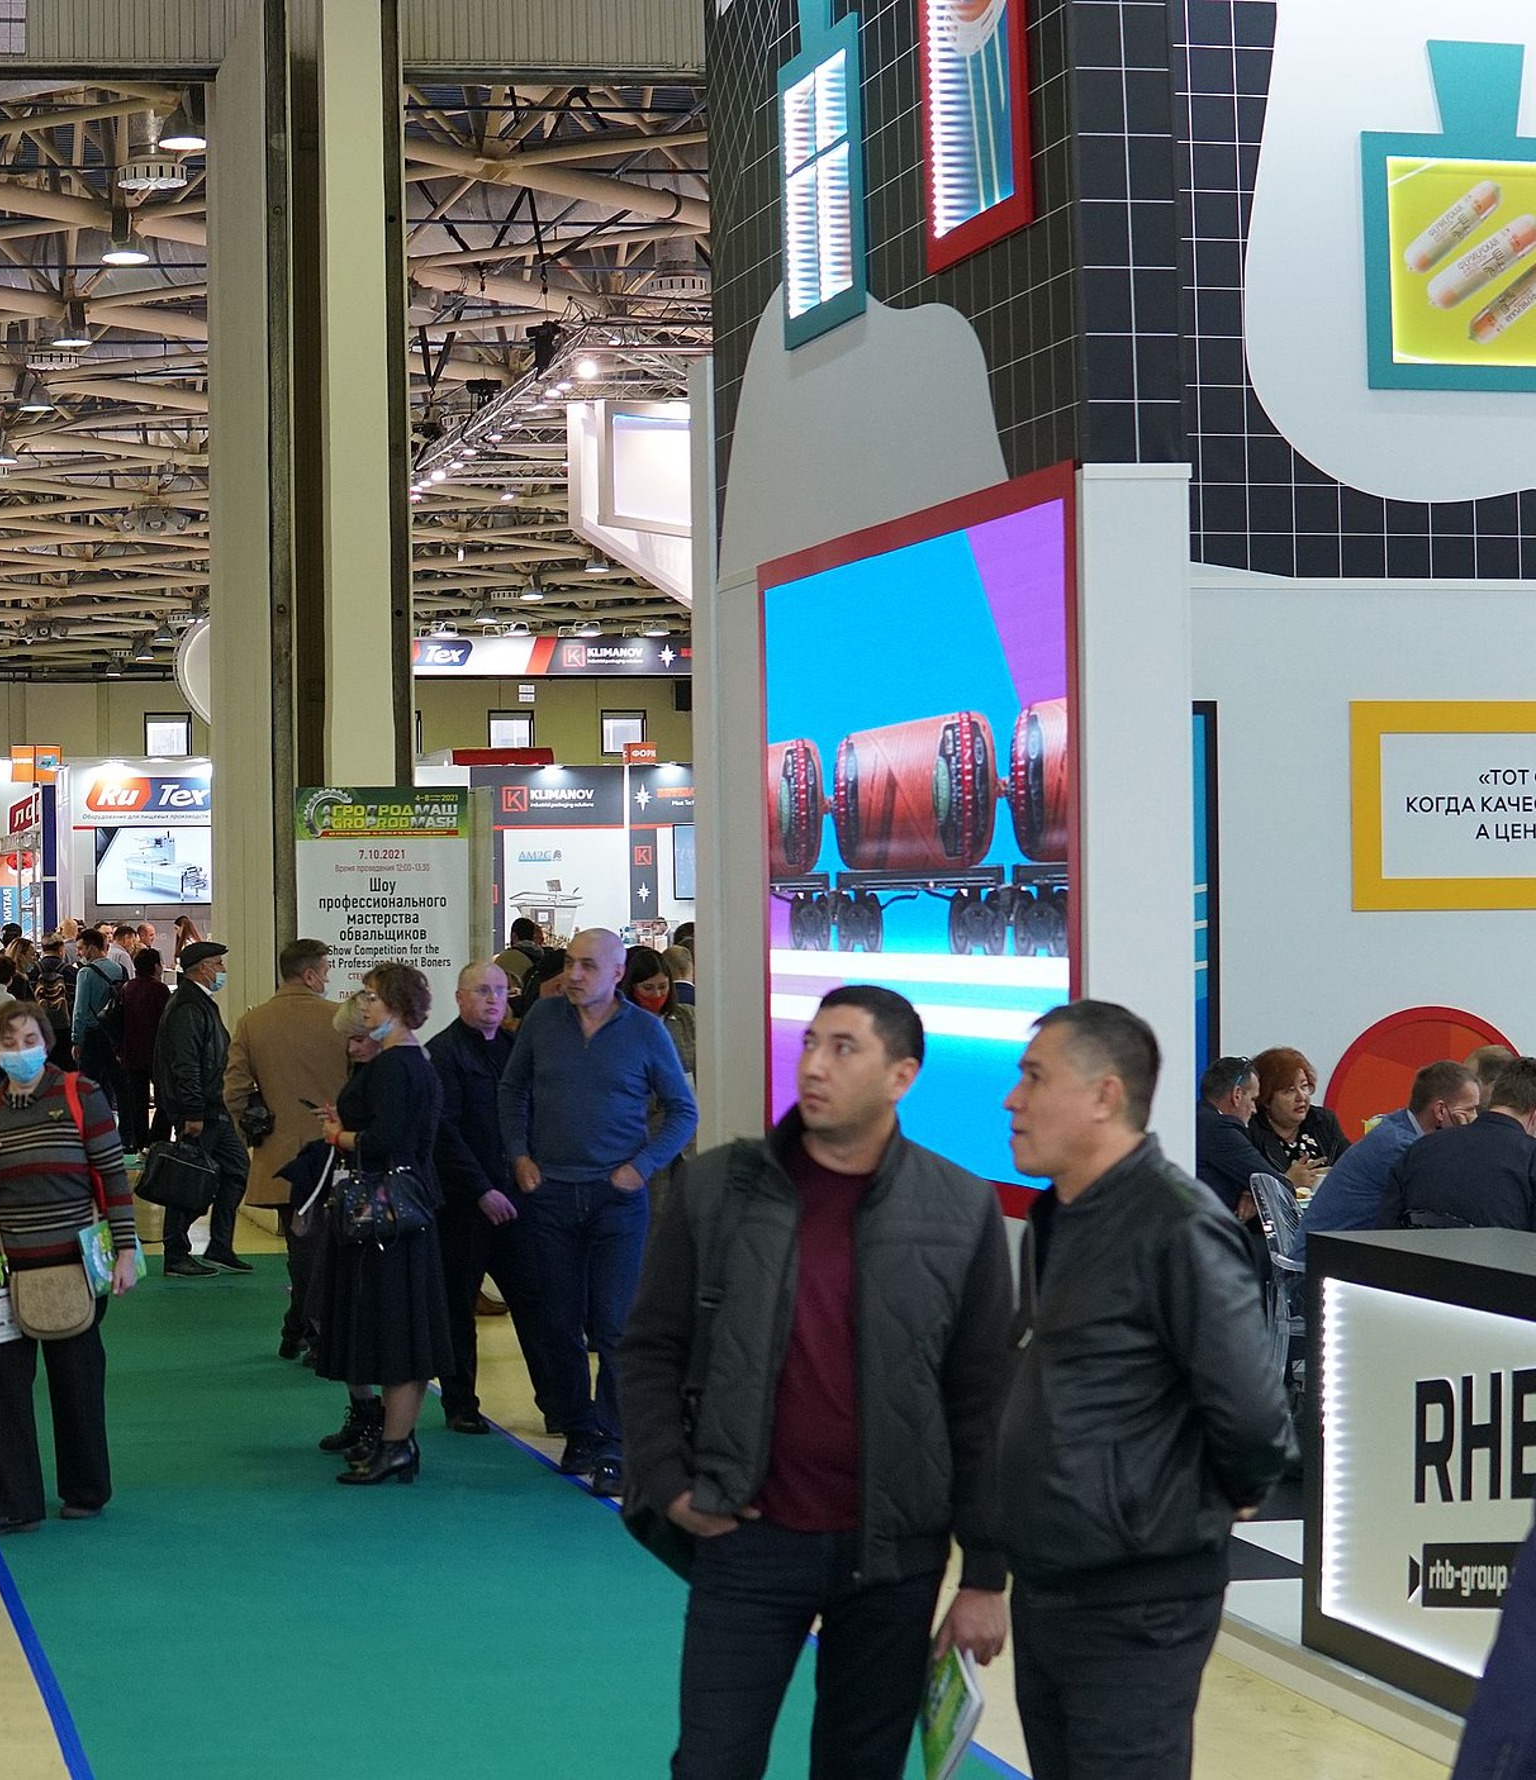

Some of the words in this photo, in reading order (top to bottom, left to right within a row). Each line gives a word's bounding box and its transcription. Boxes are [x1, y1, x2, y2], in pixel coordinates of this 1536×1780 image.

[425, 645, 465, 663] Tex
[587, 647, 644, 657] KLIMANOV
[1479, 769, 1530, 785] «ТОТ
[158, 784, 211, 807] Tex
[530, 789, 595, 800] KLIMANOV
[321, 803, 459, 817] АГРОПРОДМАШ
[1406, 796, 1476, 815] КОГДА
[1481, 796, 1536, 813] КАЧЕ
[321, 817, 458, 829] AGROPRODMASH
[1476, 823, 1490, 840] А
[358, 849, 406, 860] 7.10.2021
[334, 864, 355, 873] Время
[357, 865, 395, 873] проведения
[369, 877, 396, 895] Шоу
[319, 894, 447, 912] профессионального
[346, 912, 420, 927] мастерства
[339, 926, 427, 942] обвальщиков
[328, 945, 351, 956] Show
[354, 944, 407, 957] Competition
[410, 943, 422, 954] for
[425, 943, 440, 954] the
[338, 957, 392, 969] Professil
[420, 957, 451, 967] Boners
